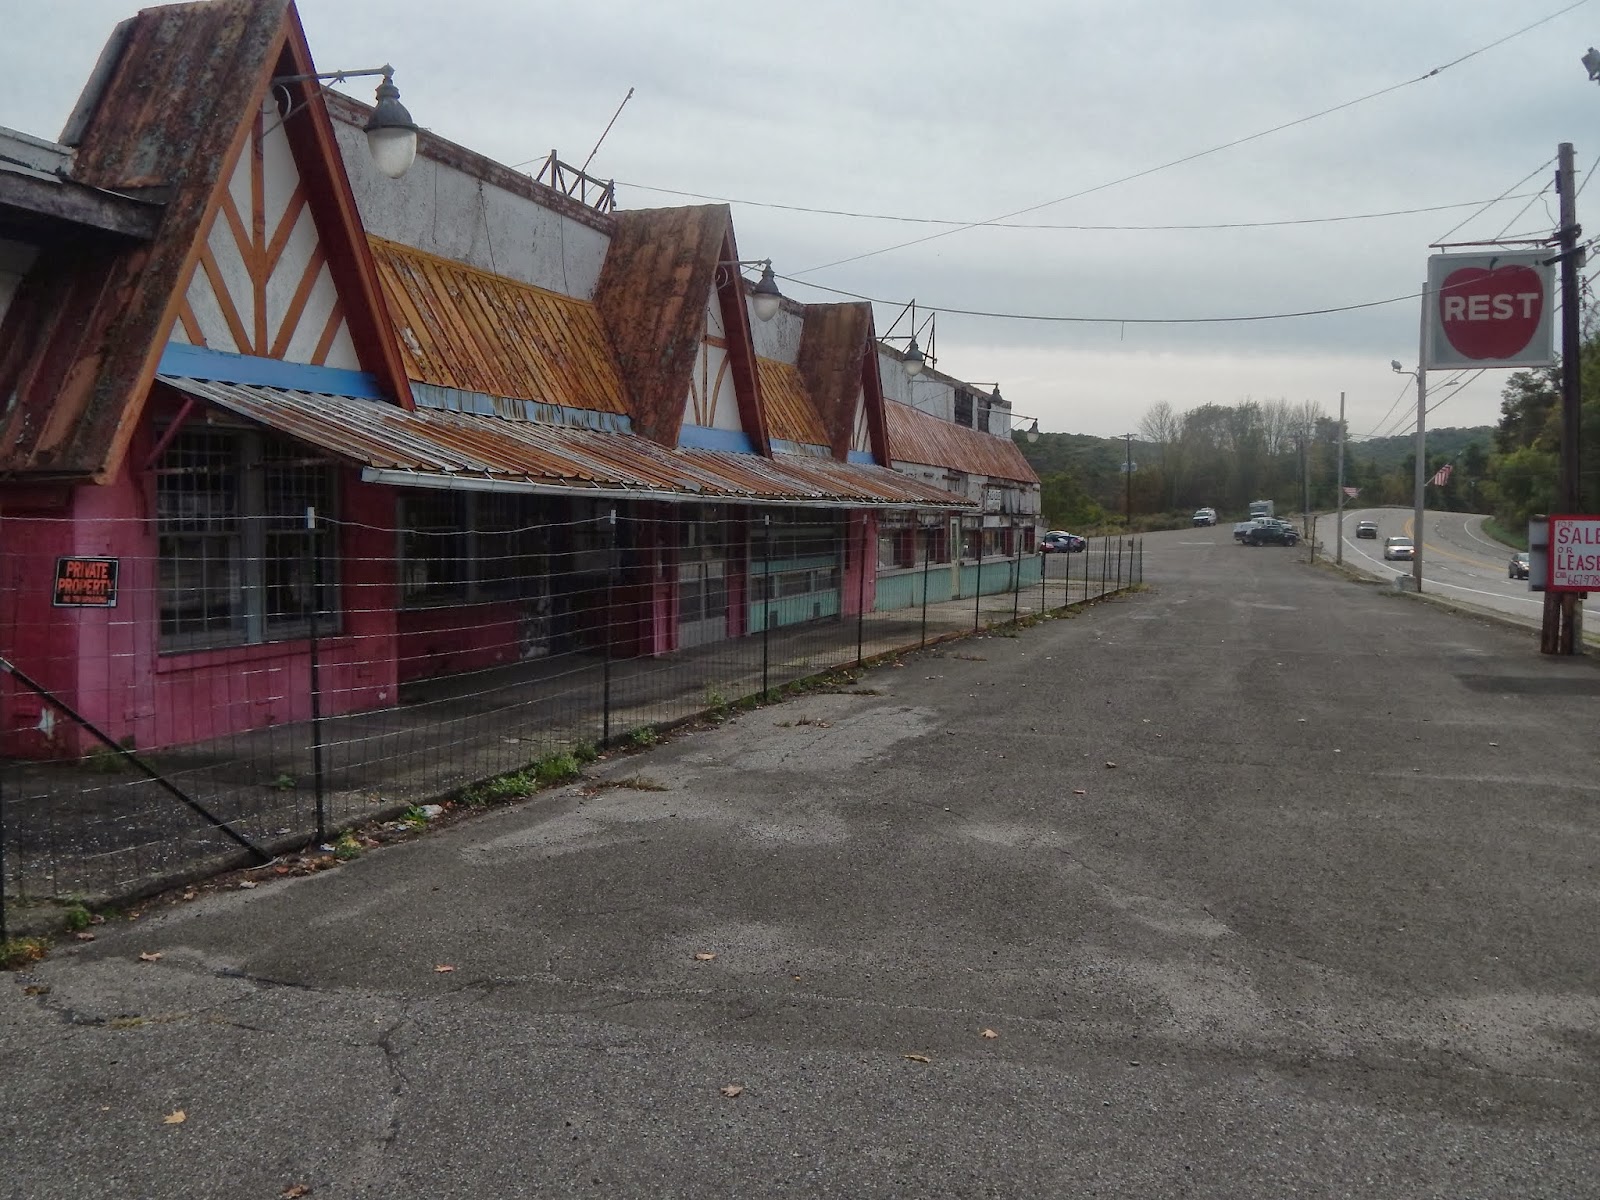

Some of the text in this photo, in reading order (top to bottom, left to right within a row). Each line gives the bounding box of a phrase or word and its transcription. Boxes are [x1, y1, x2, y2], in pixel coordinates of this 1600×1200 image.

[1444, 292, 1539, 321] REST
[1557, 527, 1600, 544] SALE
[66, 561, 109, 579] PRIVATE
[57, 577, 113, 595] PROPERTY
